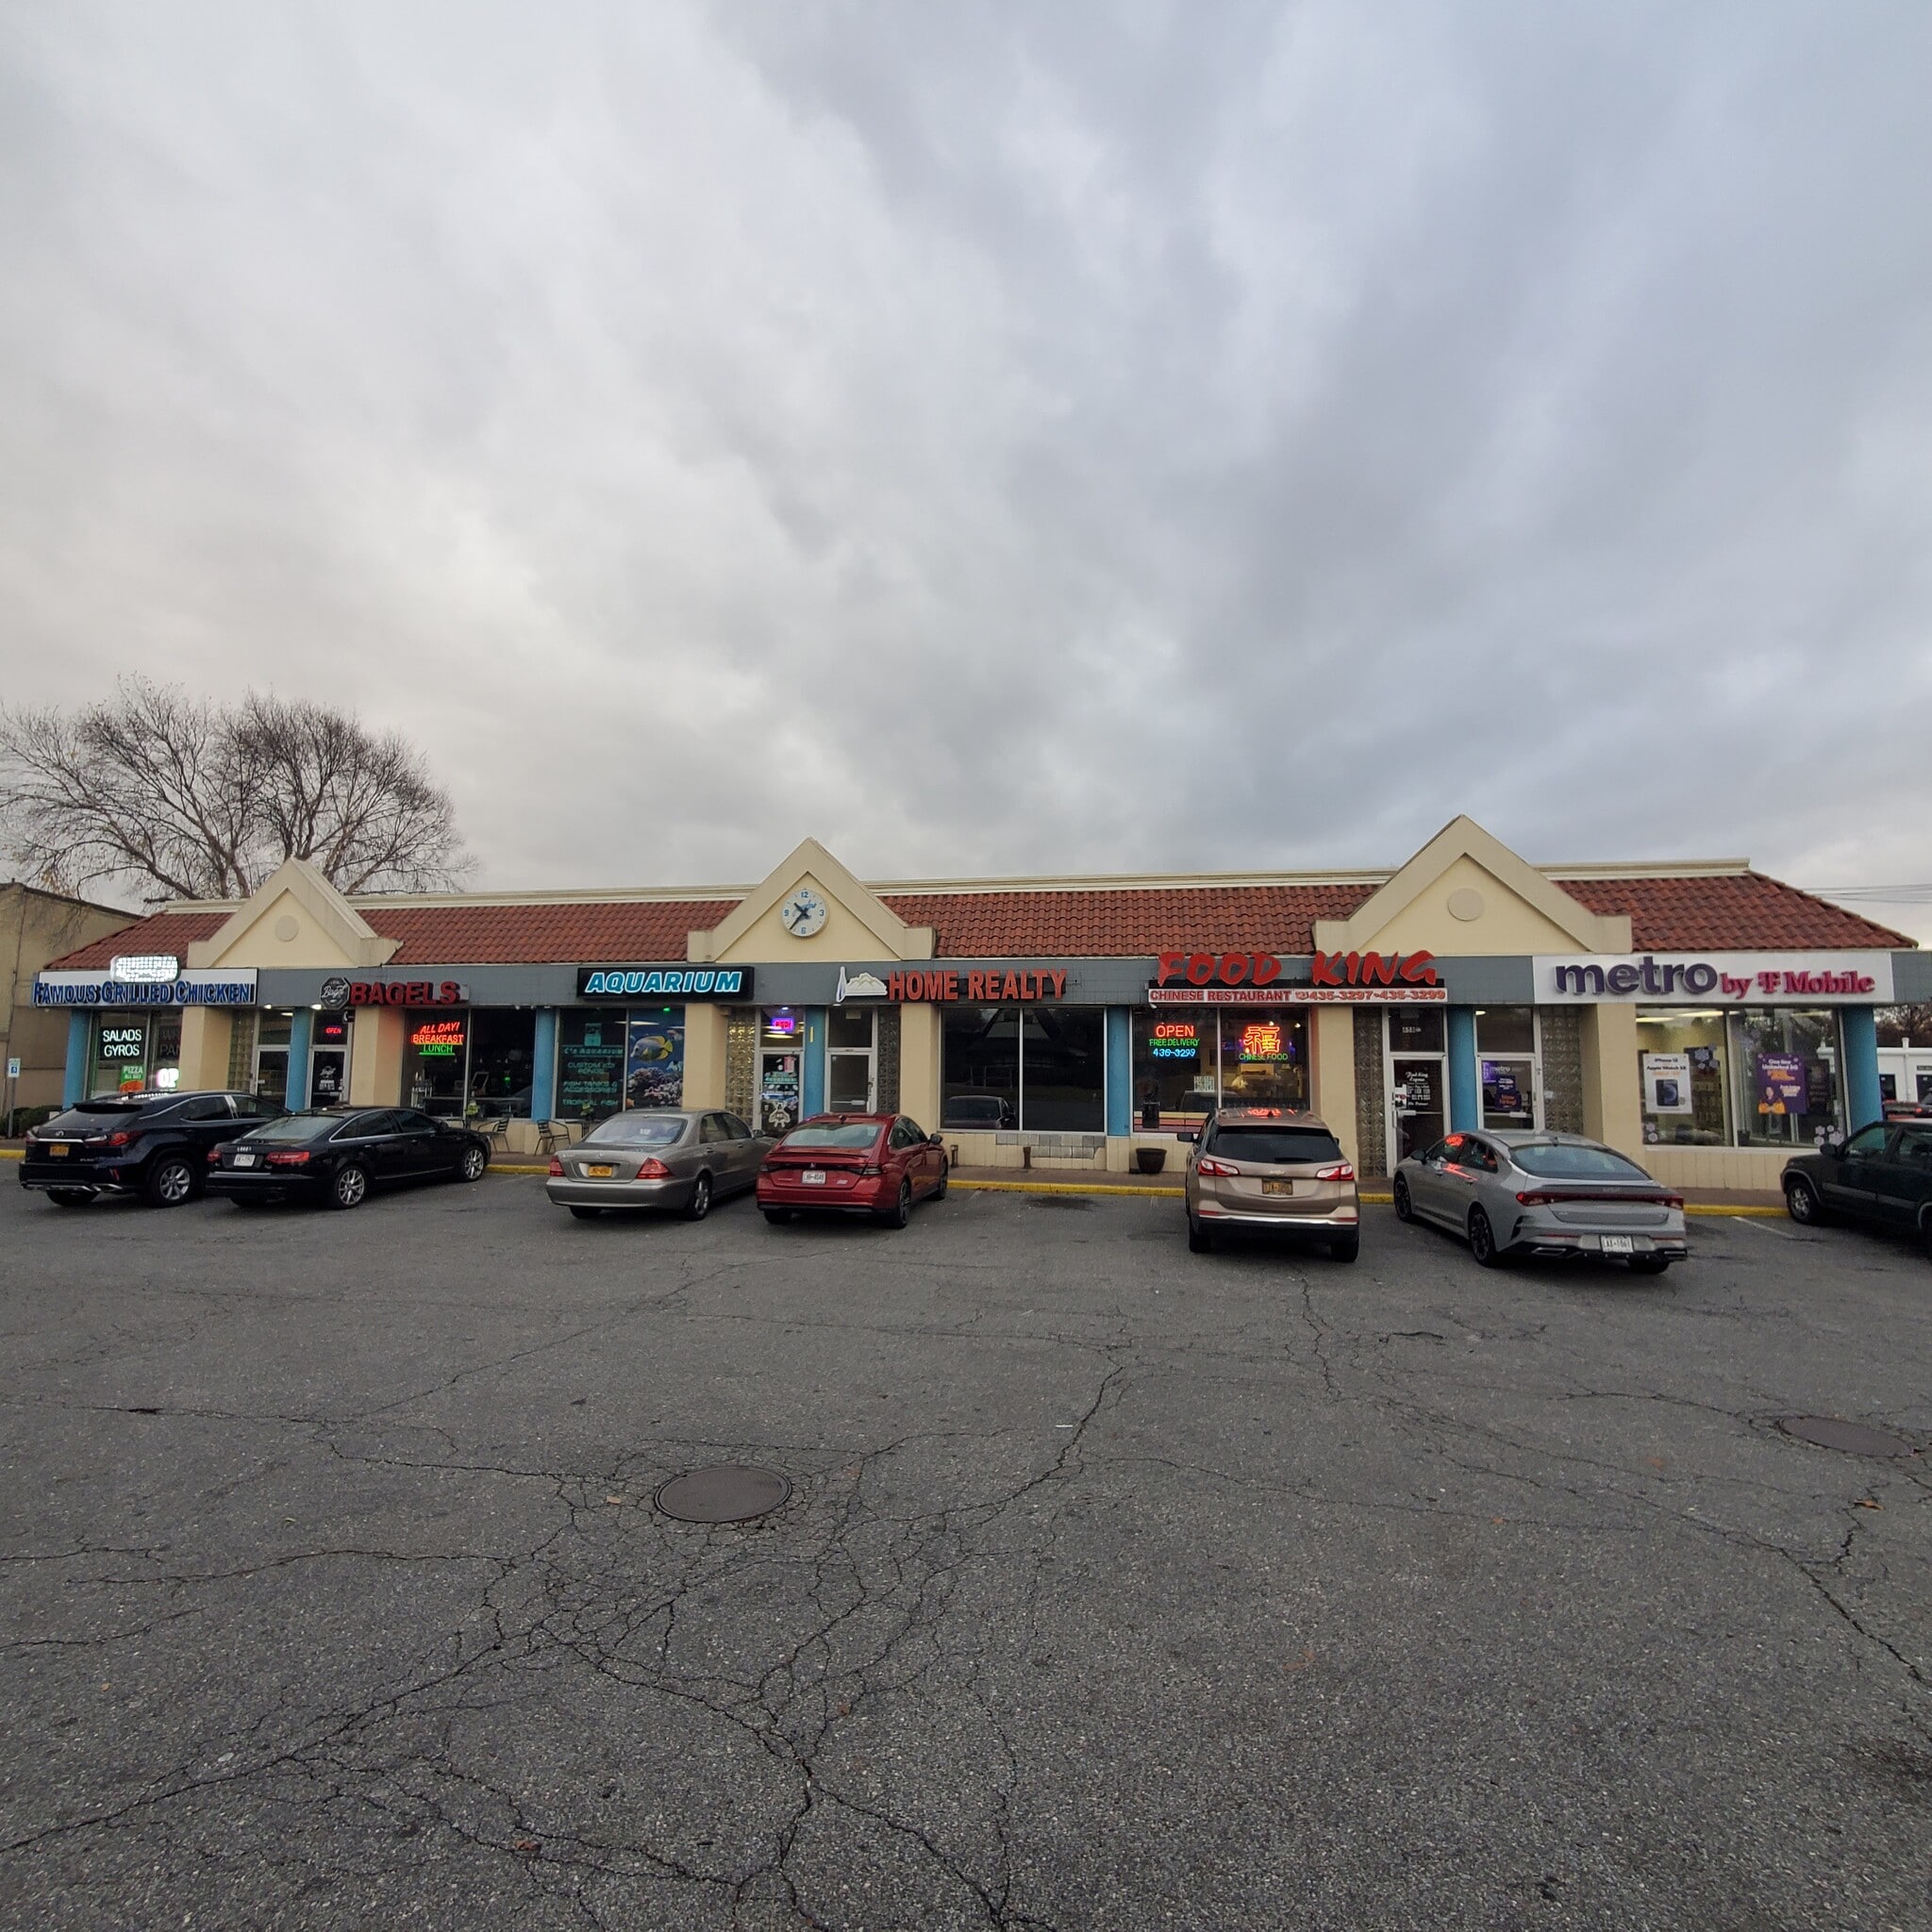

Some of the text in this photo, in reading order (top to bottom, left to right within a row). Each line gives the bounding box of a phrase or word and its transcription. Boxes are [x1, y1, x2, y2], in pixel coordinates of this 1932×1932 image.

[1158, 950, 1437, 987] FOOD KING
[585, 972, 742, 993] AQUARIUM
[889, 969, 1067, 1001] HOME REALTY
[1556, 956, 1718, 993] metro
[1720, 973, 1753, 1000] by
[1784, 971, 1875, 993] Mobile
[33, 981, 250, 1004] FAMOUS GRILLED CHICKEN
[350, 981, 458, 1006] BAGELS
[1150, 991, 1204, 1002] CHINESE
[1208, 991, 1291, 1002] RESTAURANT
[103, 1029, 142, 1042] SALADS
[420, 1024, 436, 1034] ALL
[1156, 1024, 1194, 1038] OPEN
[413, 1034, 463, 1044] BREAKFAST
[1243, 1025, 1281, 1055] 福
[104, 1044, 140, 1057] GYROS
[424, 1044, 453, 1053] LUNCH
